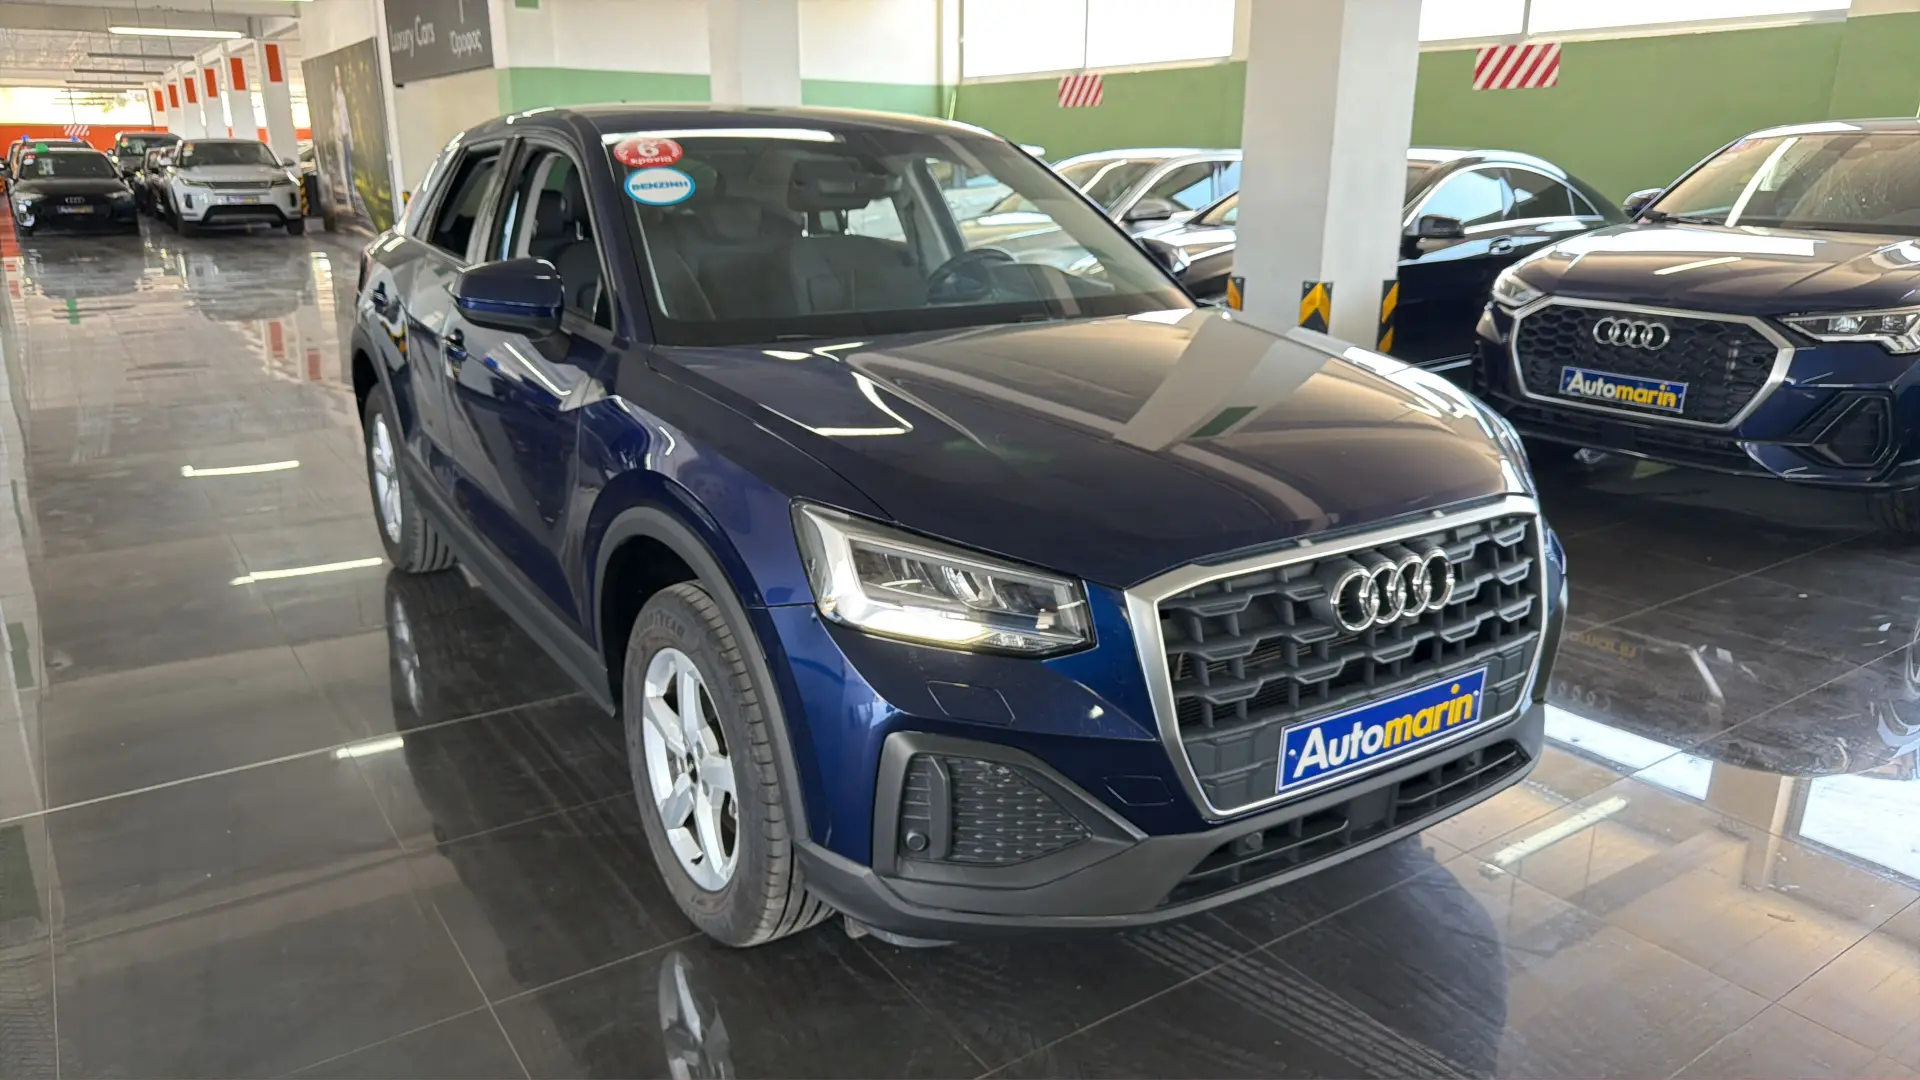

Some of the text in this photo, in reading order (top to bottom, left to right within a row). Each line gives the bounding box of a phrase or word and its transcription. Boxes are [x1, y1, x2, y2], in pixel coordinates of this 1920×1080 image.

[414, 14, 435, 47] Cars
[1567, 369, 1677, 408] Automarin
[1293, 683, 1474, 779] Automarin
